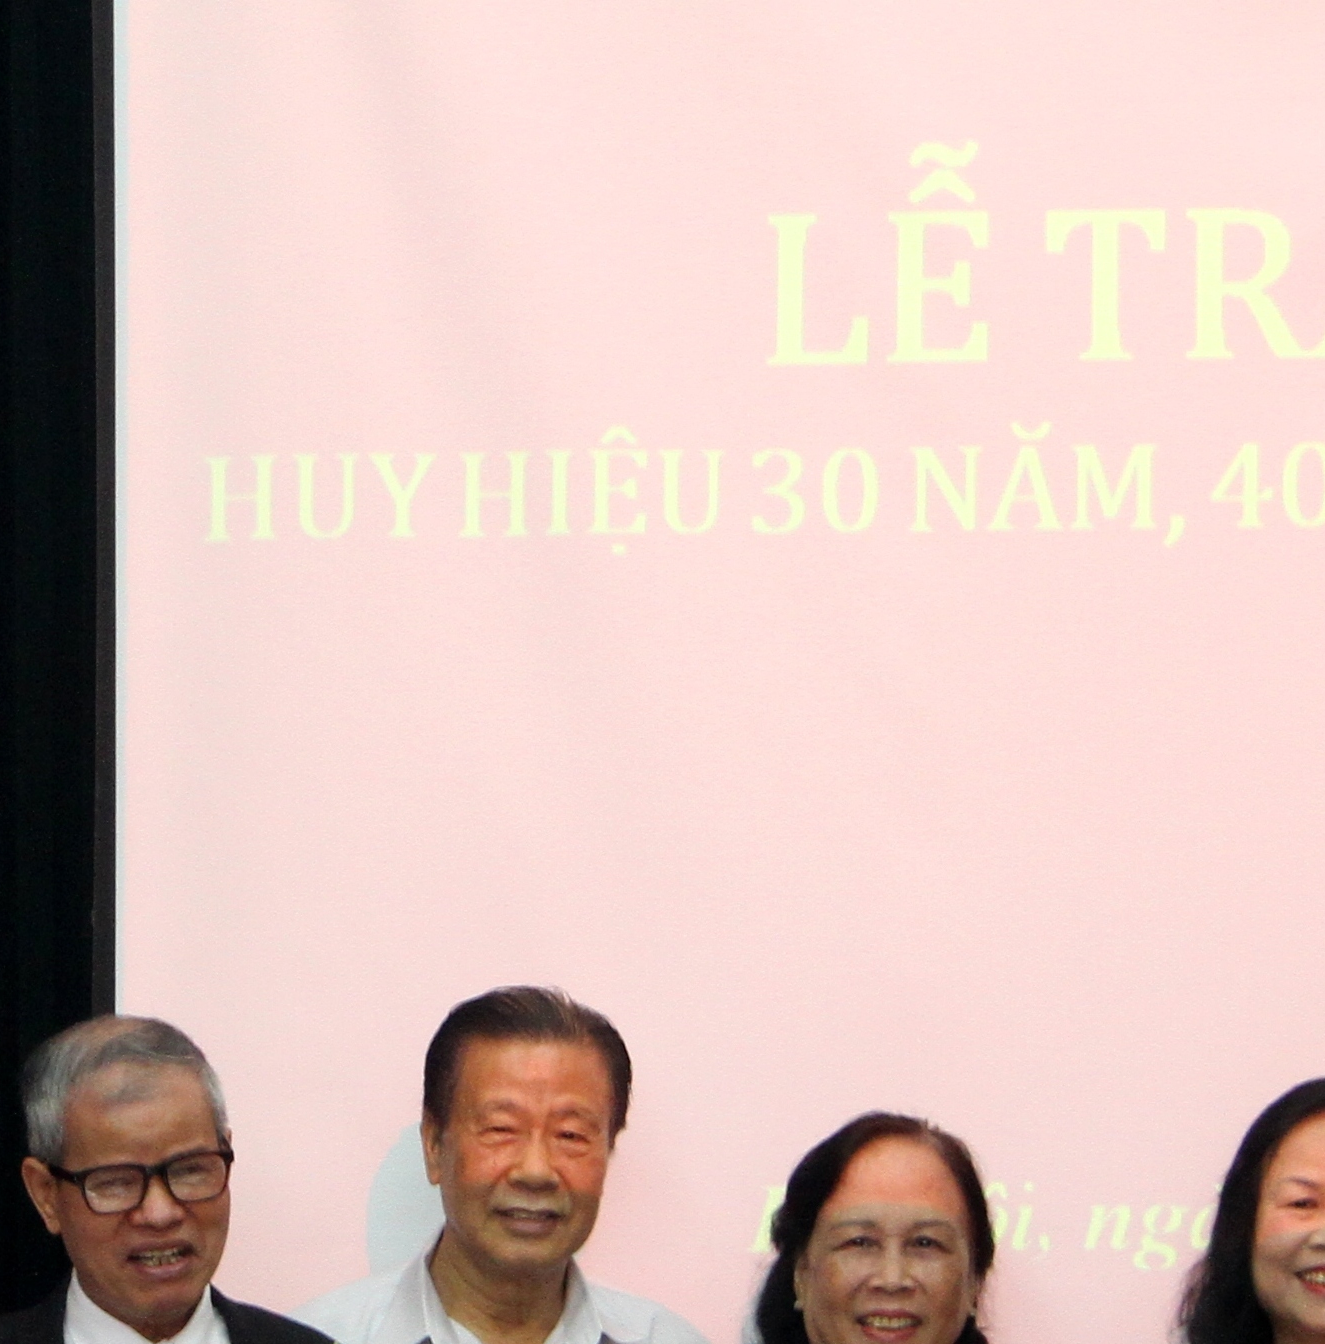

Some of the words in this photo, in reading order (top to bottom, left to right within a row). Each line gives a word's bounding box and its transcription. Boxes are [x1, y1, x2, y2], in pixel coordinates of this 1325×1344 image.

[765, 138, 993, 368] LỄ
[204, 450, 438, 544] HUY
[458, 423, 726, 557] HIỆU
[749, 446, 882, 536] 30
[909, 419, 1188, 549] NĂM,
